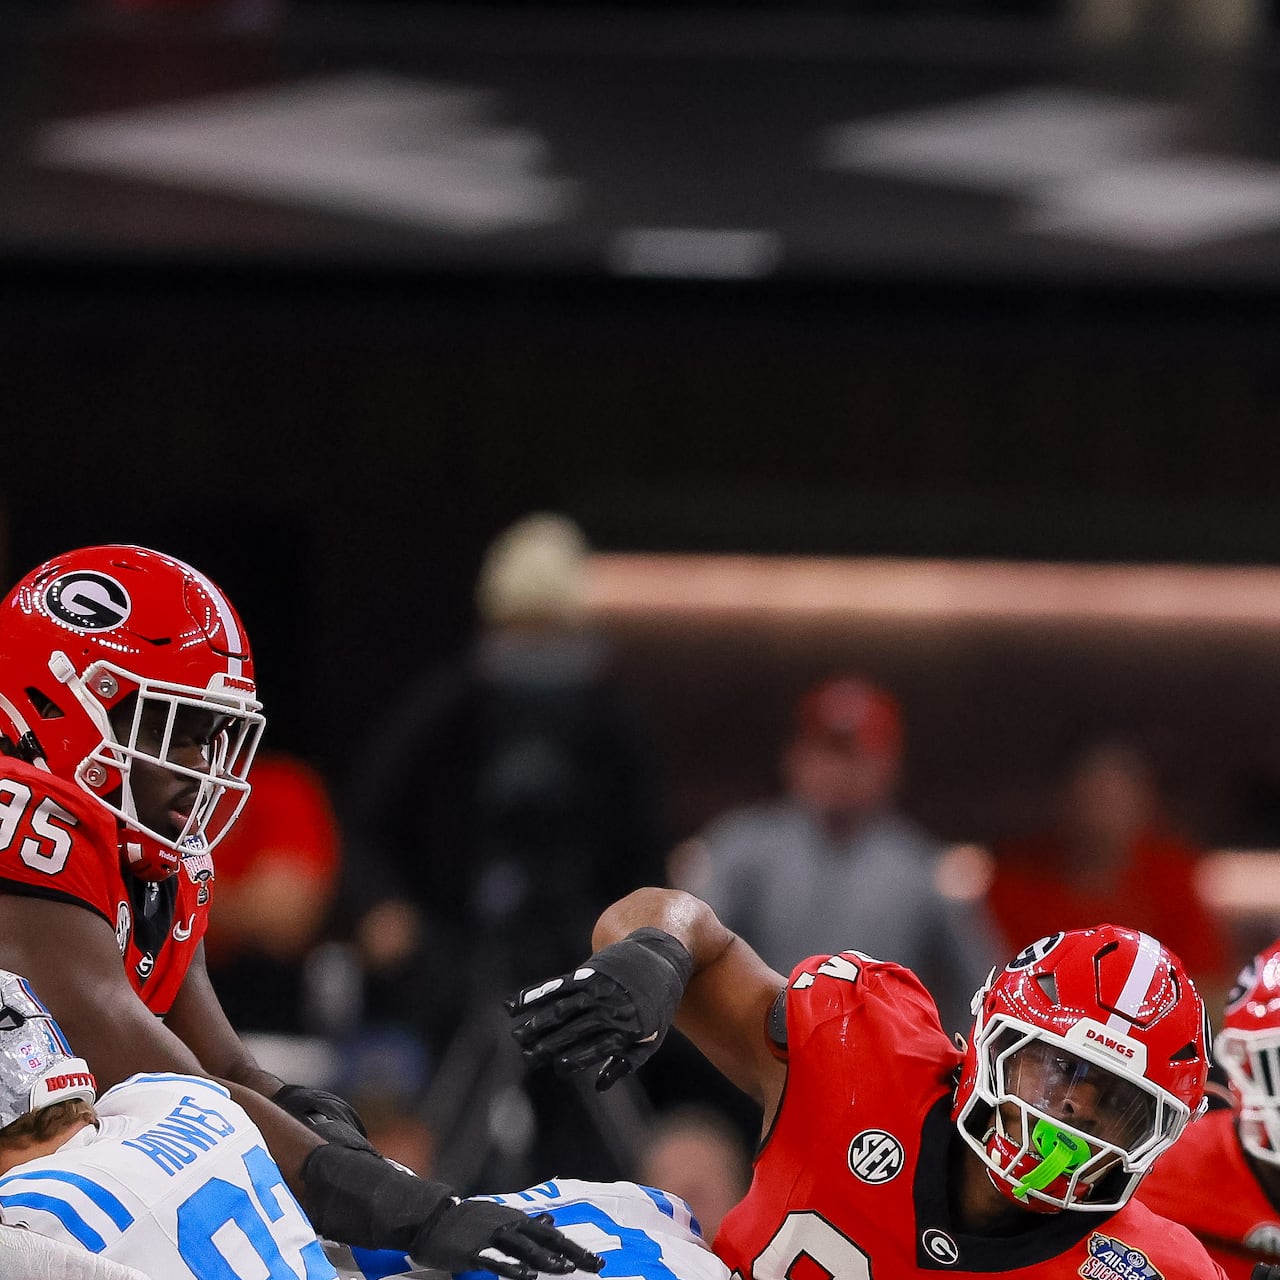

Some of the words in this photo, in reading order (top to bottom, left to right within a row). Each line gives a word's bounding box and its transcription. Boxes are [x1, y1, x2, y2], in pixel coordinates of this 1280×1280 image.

[1085, 1028, 1136, 1058] DAWGS
[121, 1095, 236, 1177] HOWES
[852, 1133, 901, 1181] SEC
